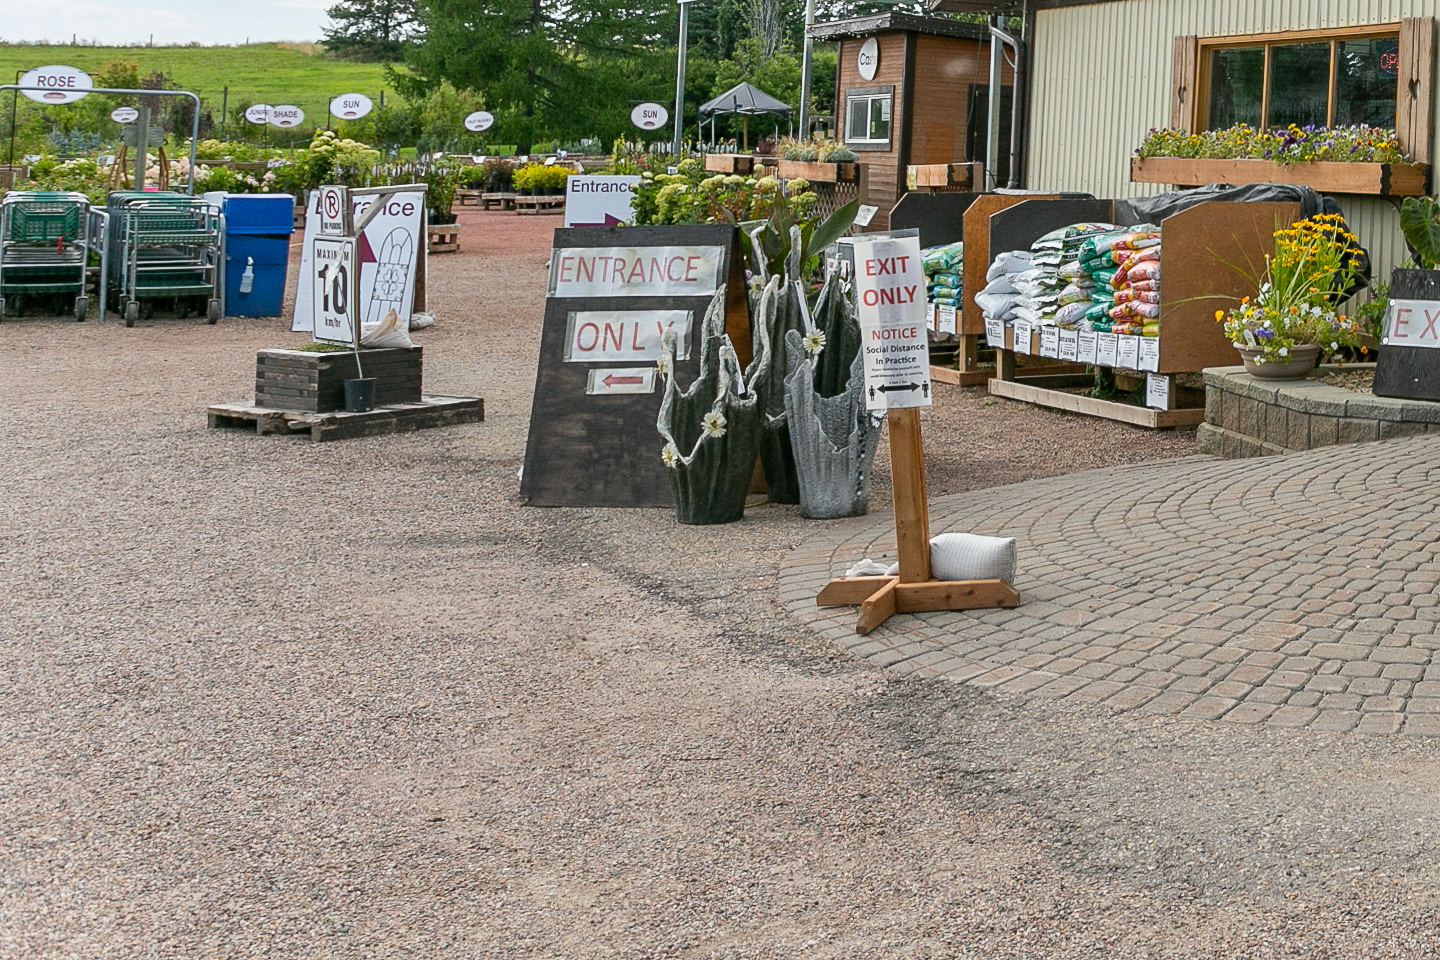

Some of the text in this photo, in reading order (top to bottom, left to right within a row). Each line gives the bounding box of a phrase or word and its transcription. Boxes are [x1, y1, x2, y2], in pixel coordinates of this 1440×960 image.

[37, 75, 76, 87] ROSE
[343, 100, 360, 109] SUN
[273, 110, 298, 118] SHADE
[643, 109, 658, 119] SUN
[571, 179, 632, 193] Entrance
[324, 221, 342, 230] NO PARKING
[316, 248, 349, 261] MAXIMM
[559, 255, 701, 284] ENTRANCE
[865, 256, 910, 276] EXIT
[317, 263, 348, 315] 10
[863, 285, 918, 307] ONLY
[324, 316, 341, 328] km/hr
[872, 327, 917, 340] NOTICE
[866, 344, 925, 354] Social Distance
[885, 356, 917, 364] Practice
